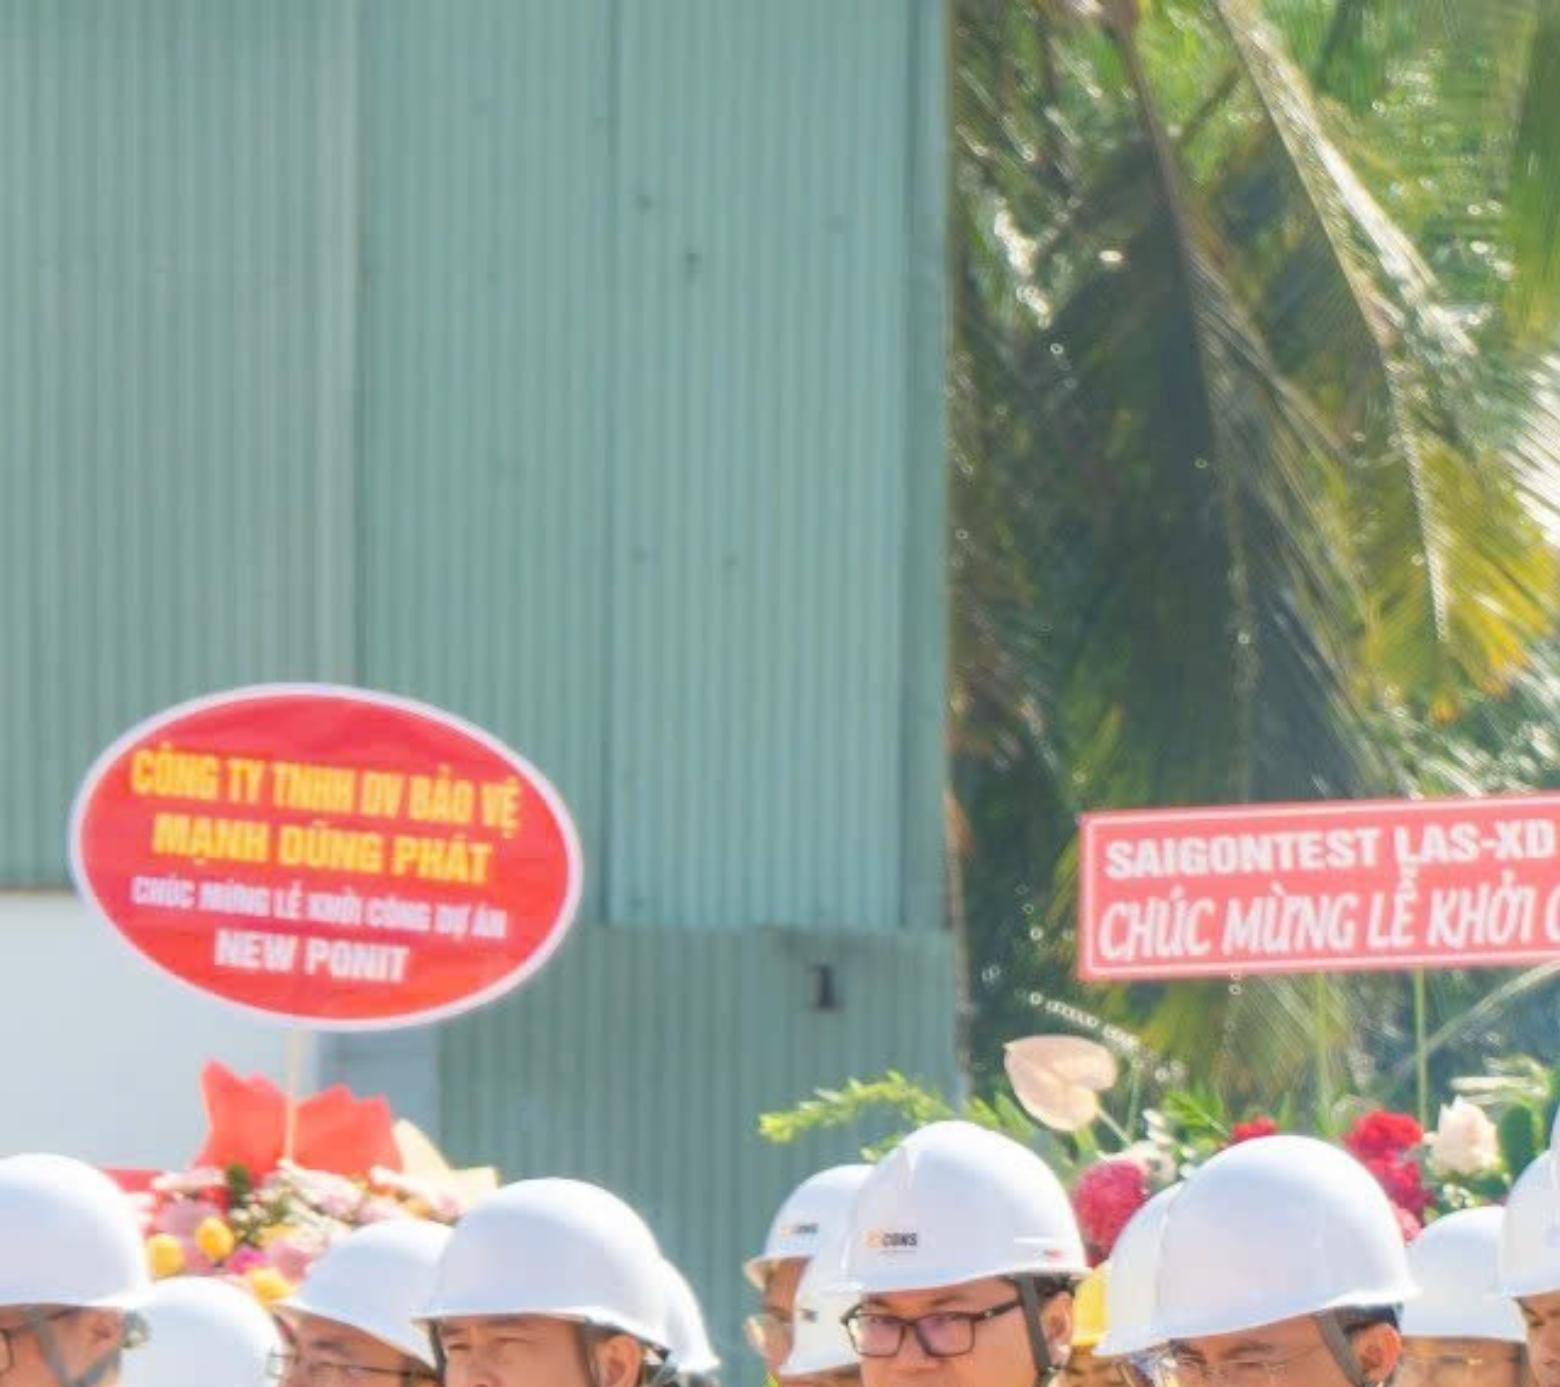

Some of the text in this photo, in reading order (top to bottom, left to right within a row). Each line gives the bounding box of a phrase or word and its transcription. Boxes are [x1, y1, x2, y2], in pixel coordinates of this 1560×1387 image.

[131, 740, 521, 839] CÔNG TY TNHH DV BẢO VỆ
[153, 812, 493, 886] MẠNH DŨNG PHÁT
[1104, 827, 1382, 880] SAIGONTEST
[1393, 817, 1557, 864] LAS-XD
[1098, 885, 1216, 963] CHÚC
[1222, 879, 1360, 956] MỪNG
[1426, 868, 1536, 947] KHỞI
[214, 928, 411, 984] NEW PONIT
